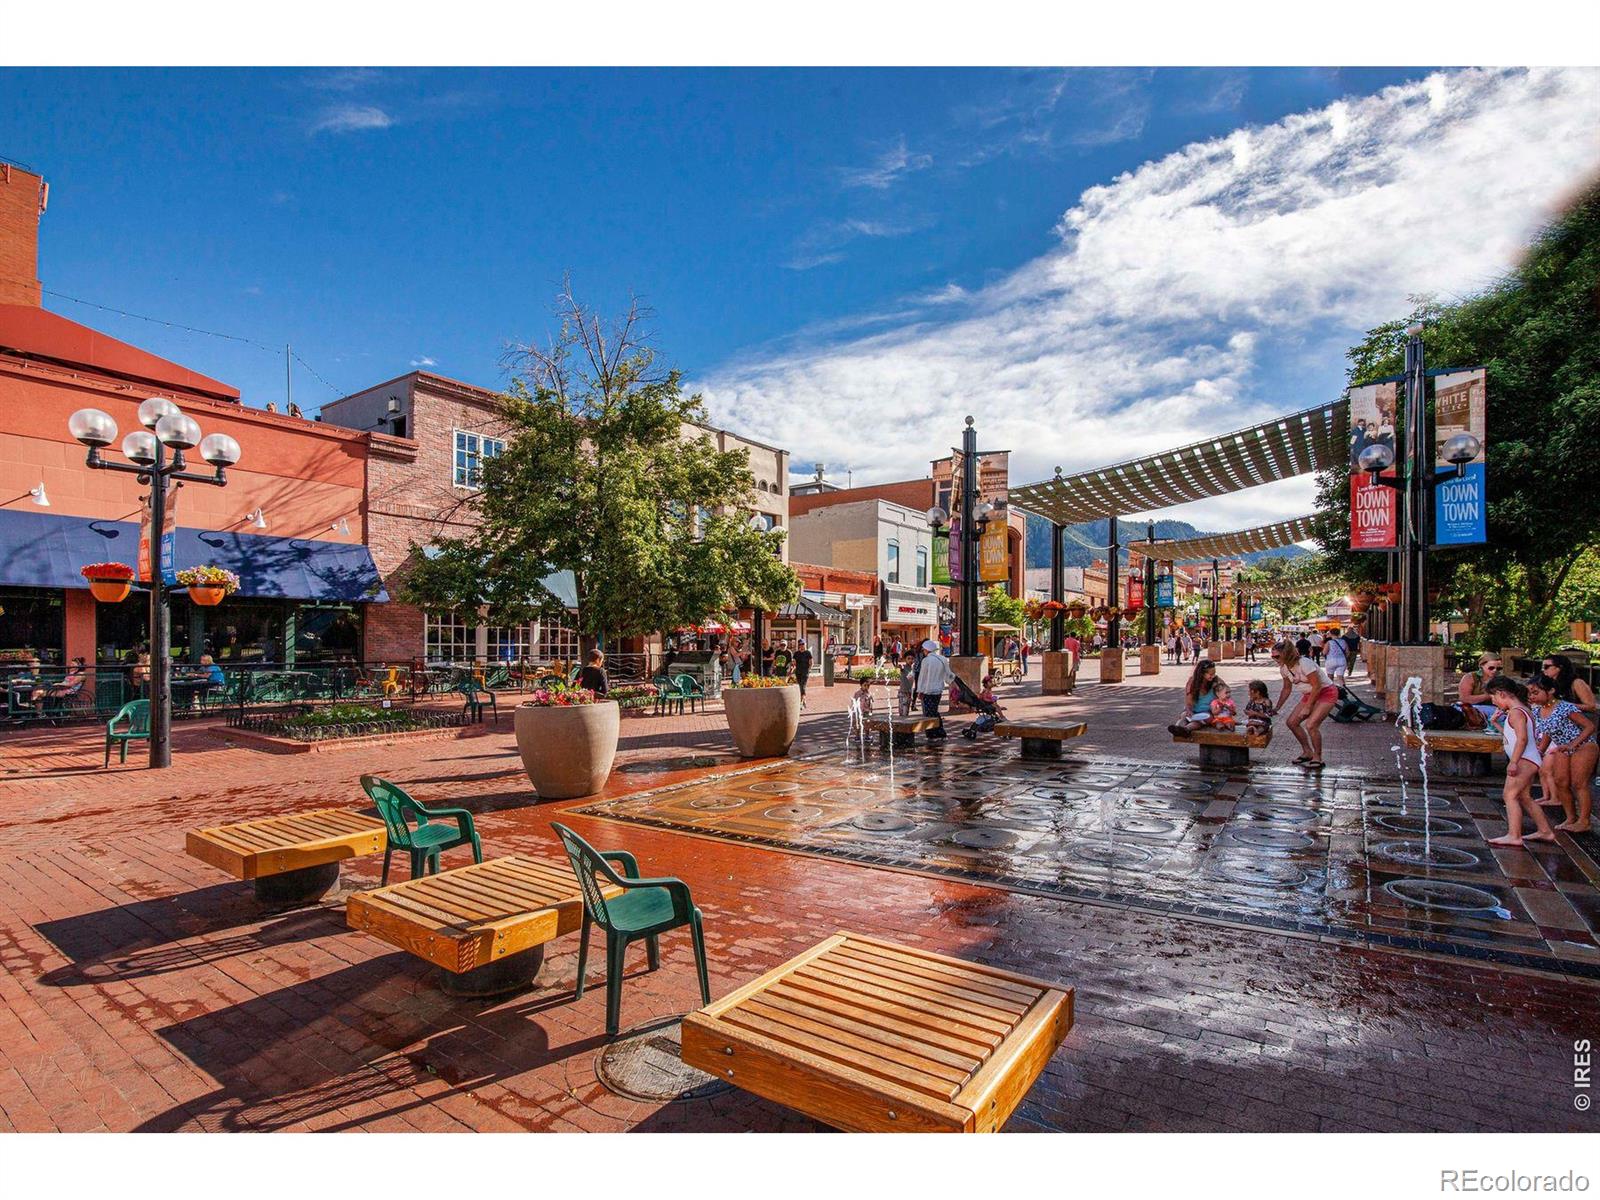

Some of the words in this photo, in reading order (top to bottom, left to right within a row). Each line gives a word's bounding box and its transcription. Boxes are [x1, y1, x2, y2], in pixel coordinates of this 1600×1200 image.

[1356, 490, 1389, 509] DOWN
[1442, 483, 1478, 503] DOWN
[1356, 508, 1389, 527] TOWN
[1443, 502, 1478, 521] TOWN
